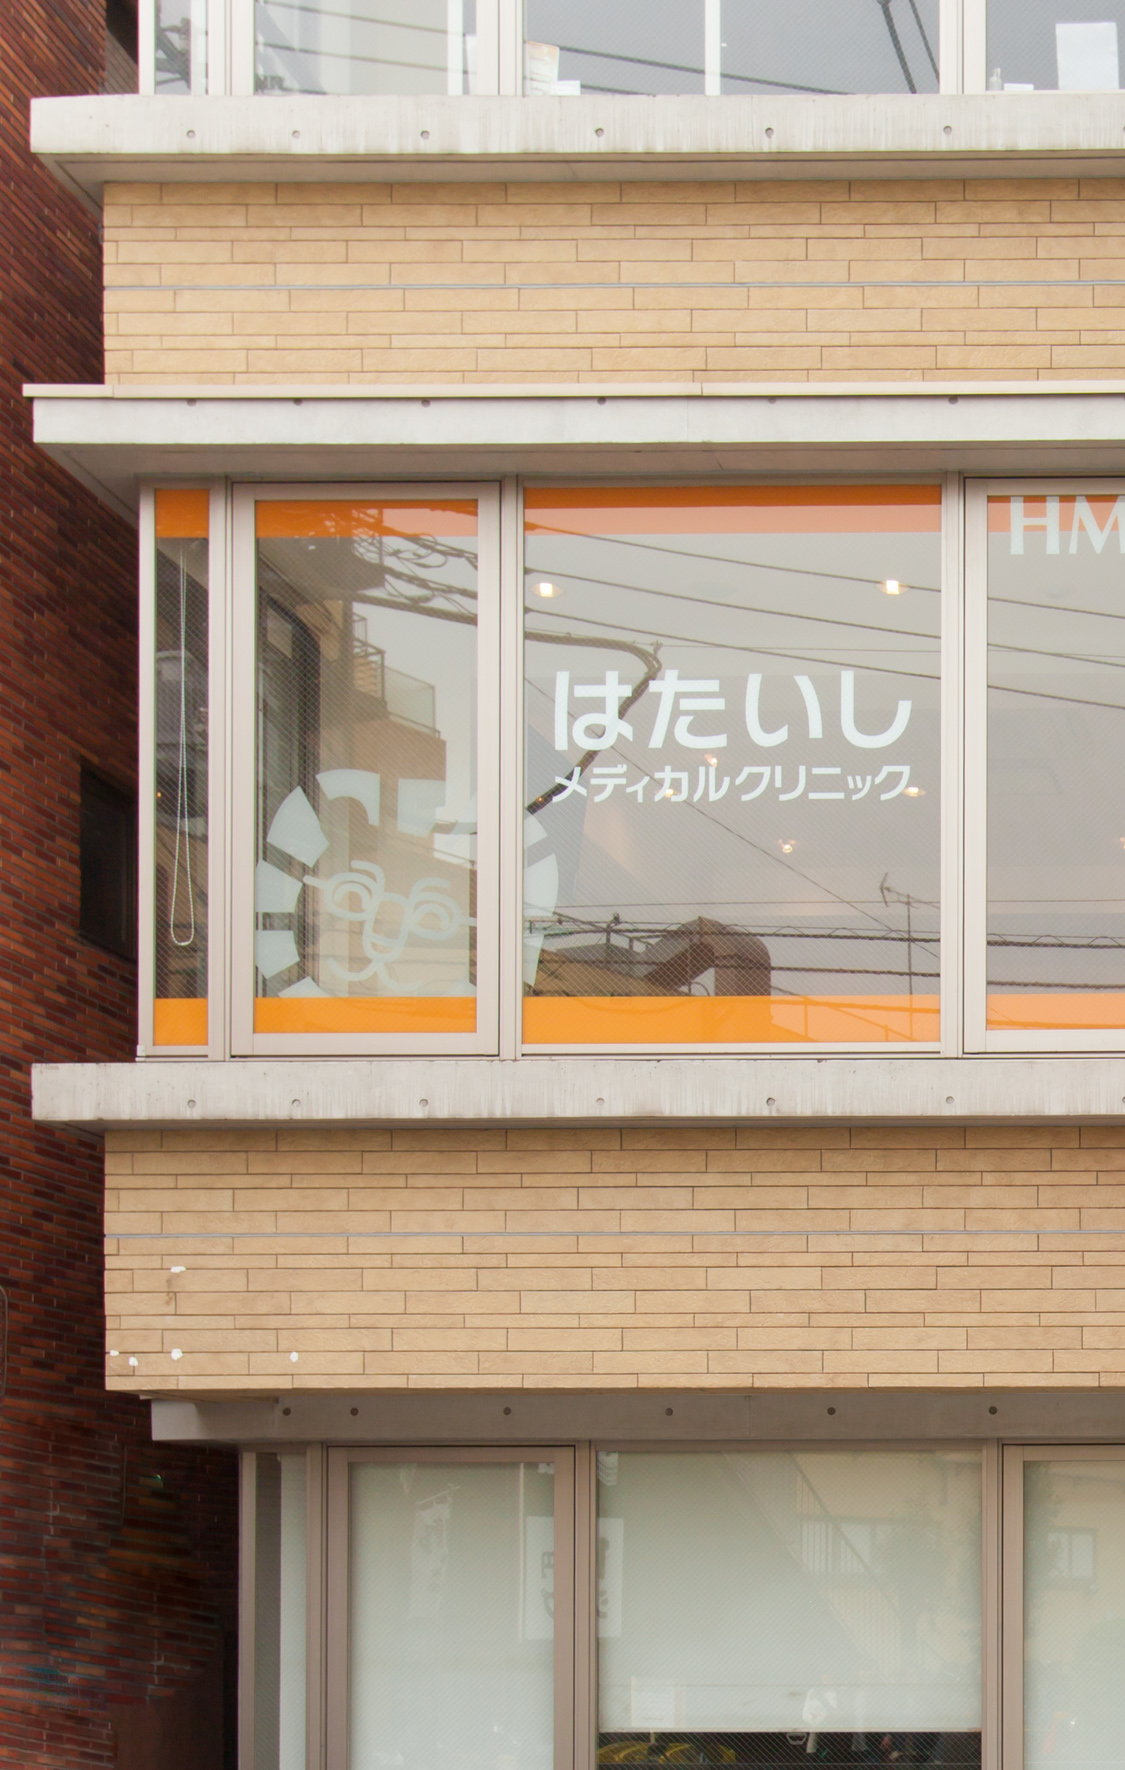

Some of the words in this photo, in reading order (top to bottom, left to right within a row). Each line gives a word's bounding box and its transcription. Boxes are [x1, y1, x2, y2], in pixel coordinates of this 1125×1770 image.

[553, 669, 912, 750] はたいし
[552, 765, 911, 803] メディカルクリニック
